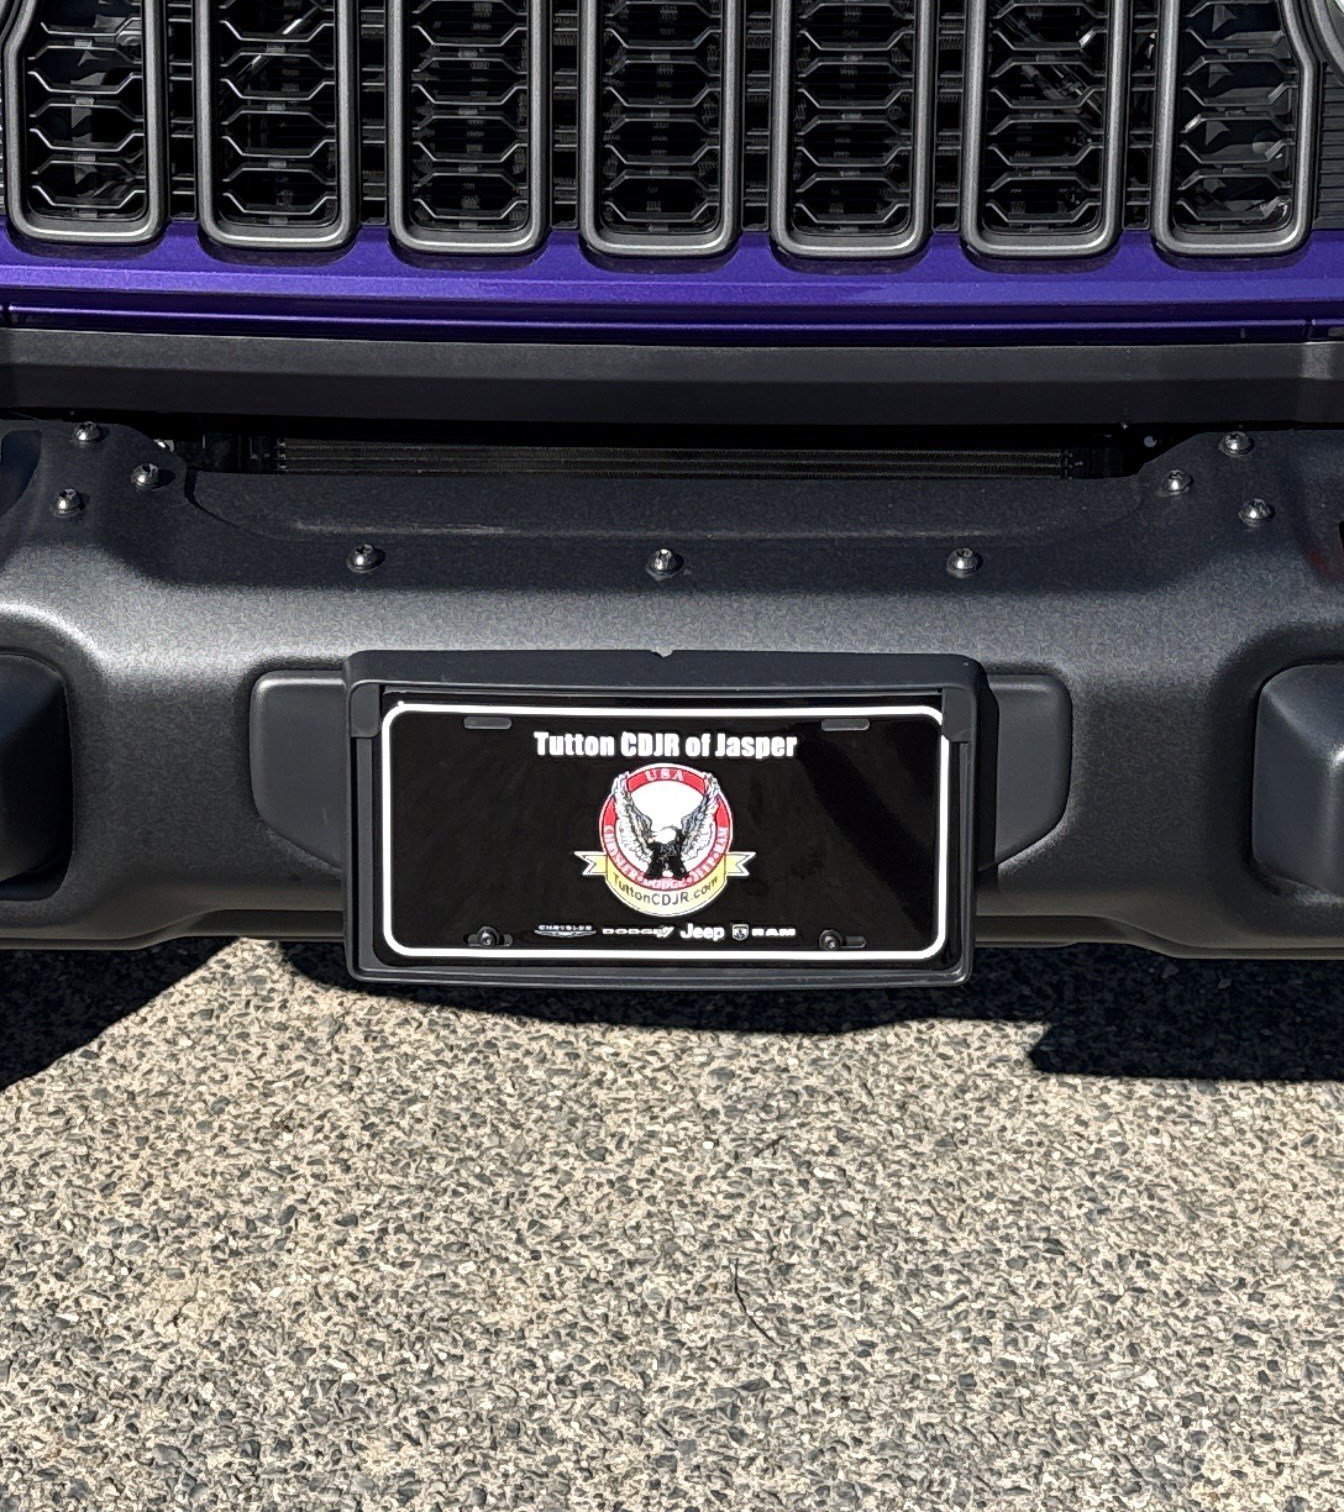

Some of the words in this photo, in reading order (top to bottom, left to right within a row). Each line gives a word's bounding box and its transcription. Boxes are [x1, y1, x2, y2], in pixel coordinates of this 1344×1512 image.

[534, 731, 615, 757] Tutton
[621, 731, 680, 757] CDJR
[685, 733, 711, 757] of
[715, 733, 798, 759] Jasper
[644, 768, 684, 782] USA
[613, 872, 718, 906] TuttonCDJR.com
[680, 923, 725, 942] Jeep
[752, 928, 796, 937] RAM
